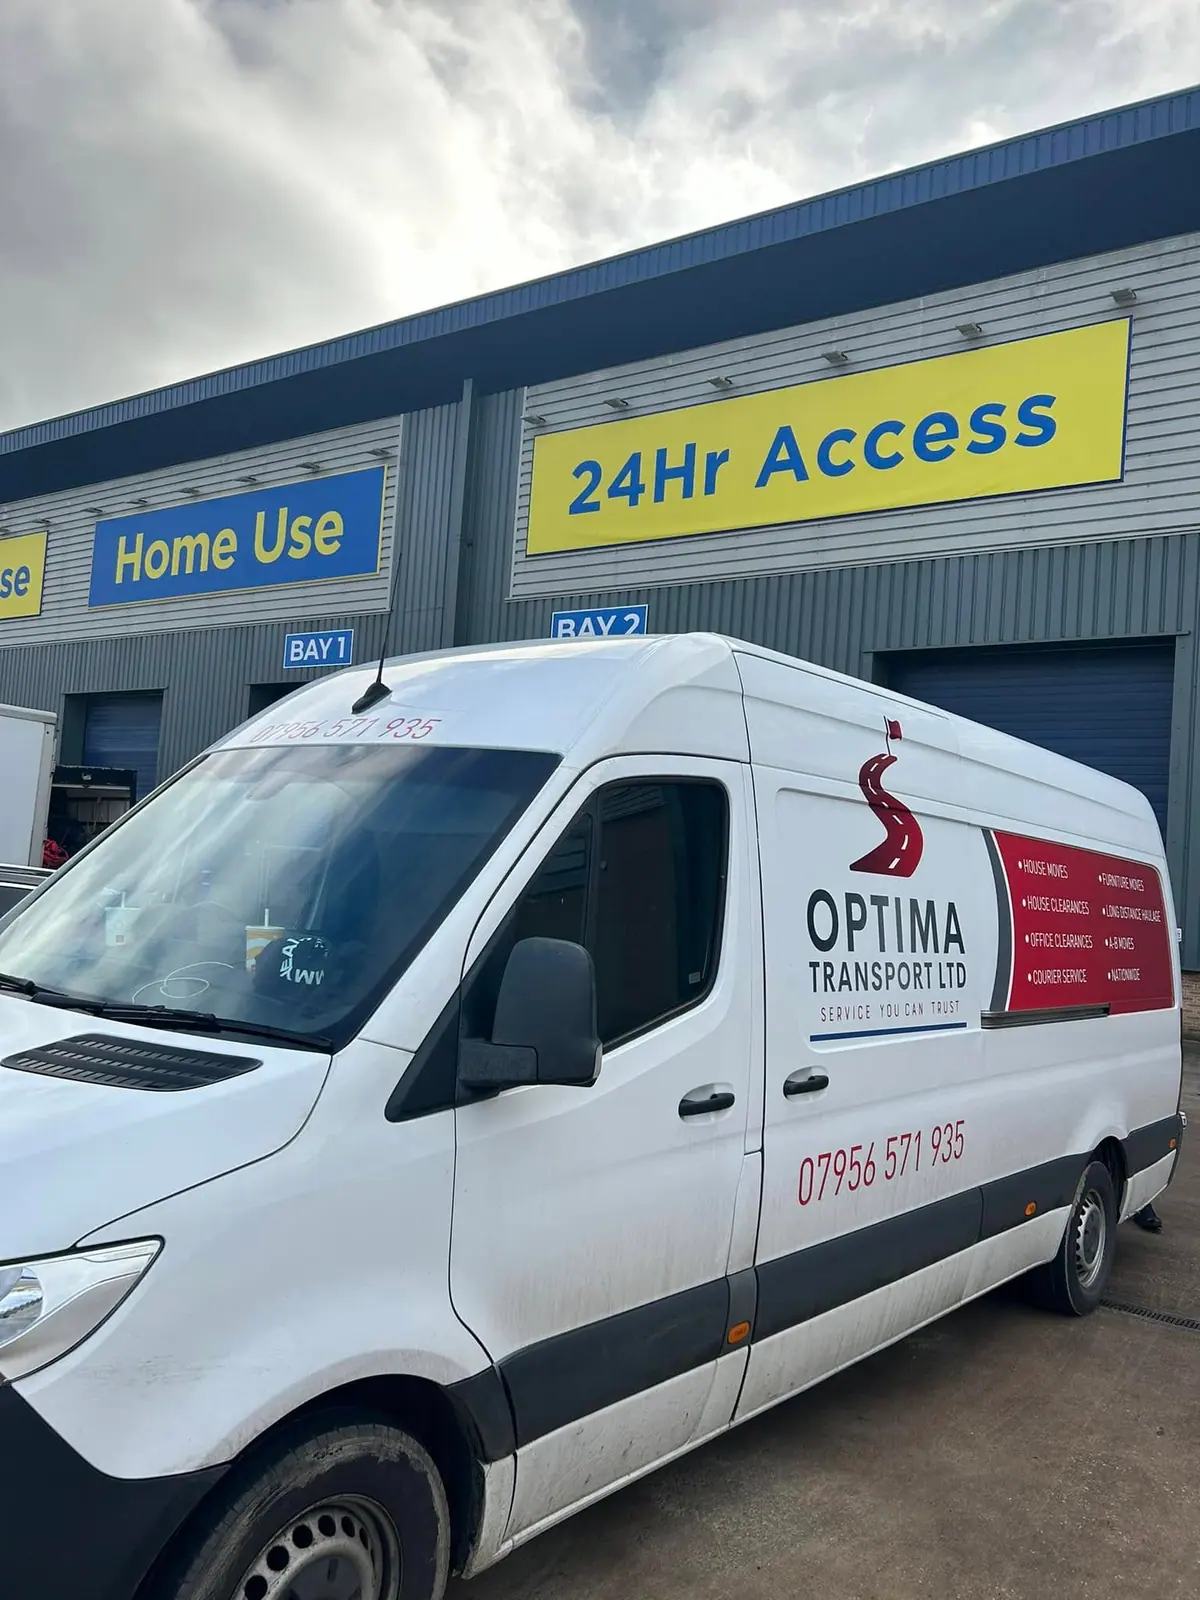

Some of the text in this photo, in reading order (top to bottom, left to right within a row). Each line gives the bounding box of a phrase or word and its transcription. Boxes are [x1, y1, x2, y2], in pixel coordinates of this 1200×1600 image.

[568, 394, 1058, 516] 24Hr Access
[115, 507, 345, 585] Home Use
[557, 613, 640, 638] BAY 2
[290, 636, 346, 662] BAY 1
[250, 717, 443, 744] 07956 571 935
[1023, 858, 1069, 879] HOUSE MOVES
[1102, 872, 1145, 892] FURNITURE MOVES
[1027, 895, 1090, 915] HOUSE CLEARANCES
[1105, 904, 1120, 918] LONG
[1119, 905, 1142, 920] DISTANCE
[807, 888, 966, 955] OPTIMA
[1030, 932, 1094, 949] OFFICE CLEARANCES
[1109, 936, 1135, 950] A-B MOVES
[808, 961, 968, 993] TRANSPORT LTD
[1033, 968, 1088, 985] COURIER SERVICE
[1111, 968, 1141, 982] NATIONWIDE
[820, 1000, 960, 1022] SERVICE YOU CAN TRUST
[798, 1119, 965, 1206] 07956 571 935
